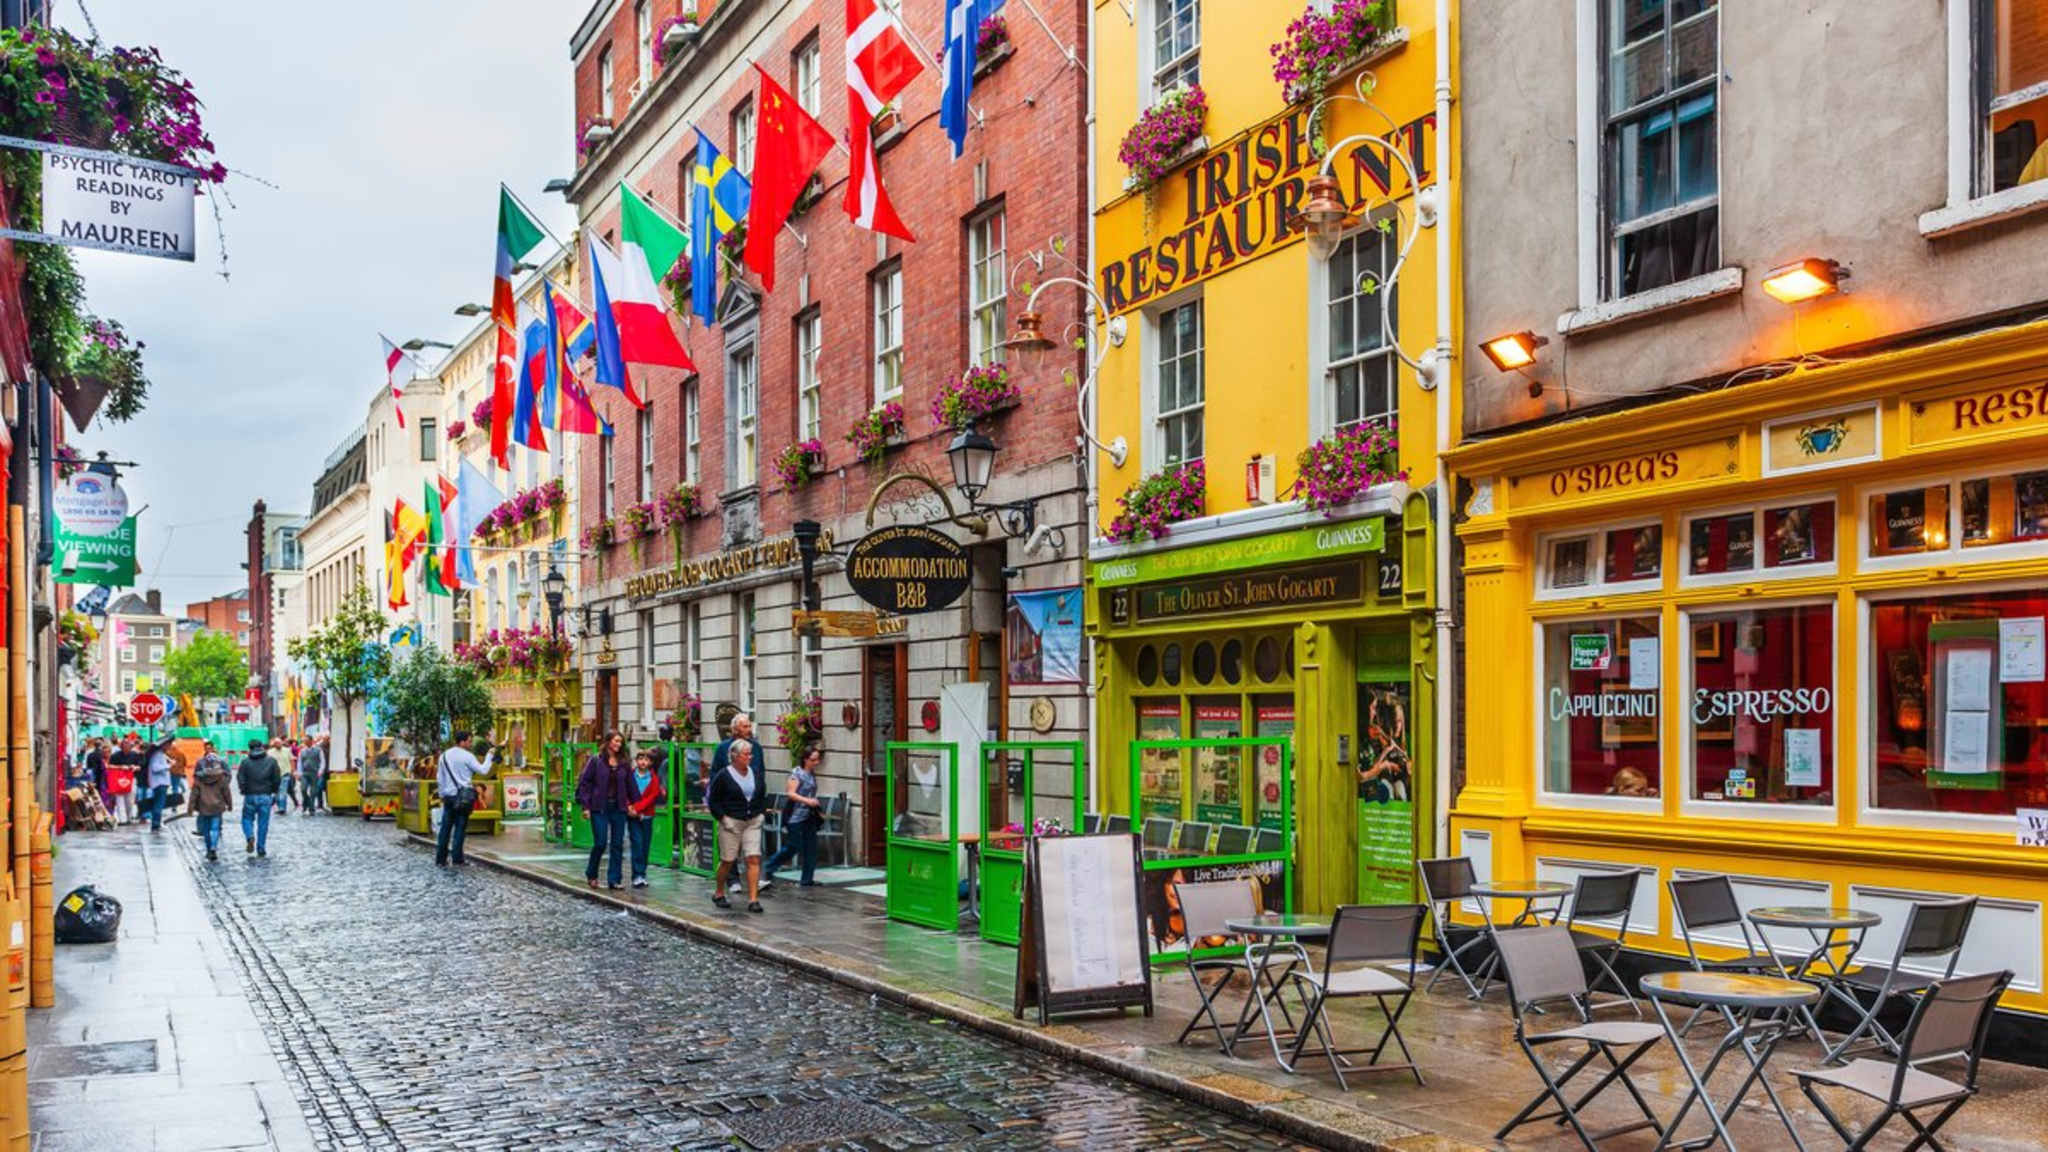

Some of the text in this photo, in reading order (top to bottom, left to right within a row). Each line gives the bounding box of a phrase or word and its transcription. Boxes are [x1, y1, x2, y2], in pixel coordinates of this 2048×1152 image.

[51, 155, 187, 187] PSYCHIC TAROT
[1184, 104, 1319, 227] IRISH
[77, 177, 164, 202] READINGS
[110, 200, 131, 215] BY
[61, 219, 179, 251] MAUREEN
[58, 540, 132, 557] VIEWING
[1317, 525, 1372, 550] GUINNESS
[760, 536, 802, 569] TEMPL
[854, 557, 967, 578] ACCOMMODATION
[1101, 563, 1137, 581] GUINNESS
[1381, 564, 1400, 589] 22
[896, 582, 927, 608] B&B
[1114, 597, 1127, 617] 22
[131, 703, 162, 715] STOP
[1194, 869, 1211, 881] Live
